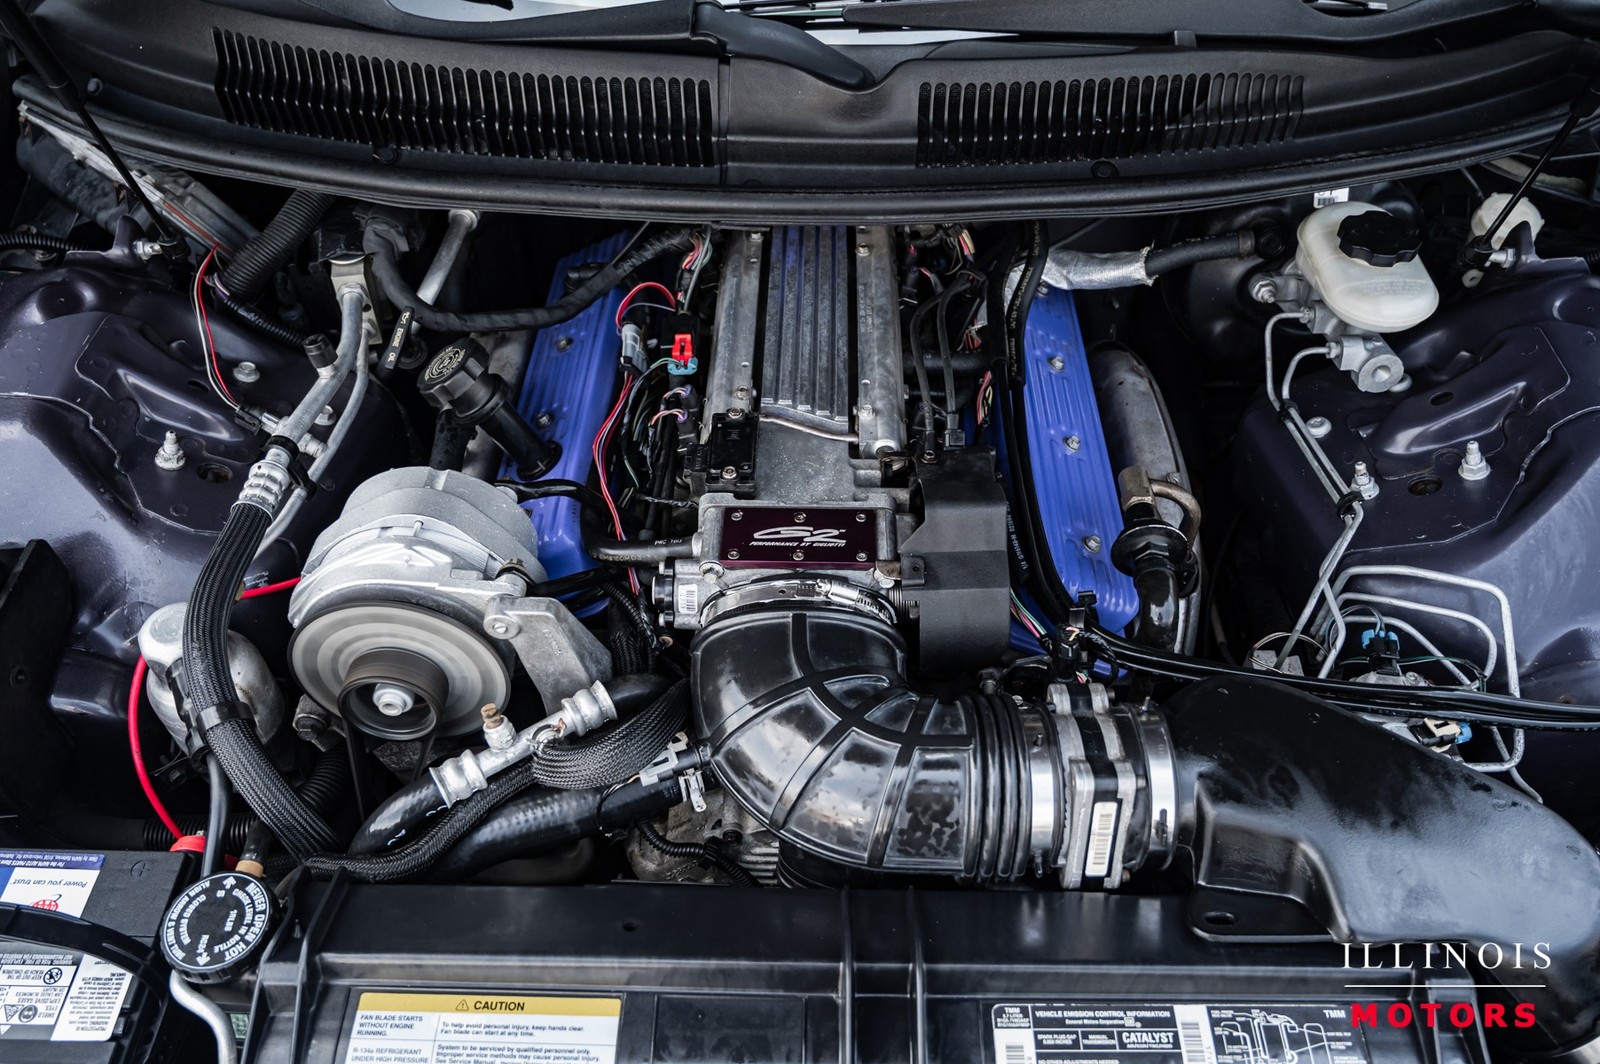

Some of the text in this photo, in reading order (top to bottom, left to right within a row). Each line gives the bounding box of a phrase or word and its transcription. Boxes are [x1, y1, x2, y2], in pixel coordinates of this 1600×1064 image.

[388, 328, 404, 362] ENGINE OIL
[64, 880, 88, 888] Power
[170, 895, 190, 920] ARROW
[213, 888, 253, 953] CHECK LEVEL IN BOTTLE
[224, 882, 266, 961] NEVER OPEN HOT
[166, 927, 176, 946] VENT
[178, 918, 191, 945] SYSTEM
[473, 1000, 525, 1012] CAUTION
[1323, 1010, 1346, 1018] TMM
[1122, 1032, 1174, 1043] CATALYST
[507, 1046, 514, 1054] by
[516, 1046, 543, 1054] qualified
[544, 1047, 575, 1055] personnel
[553, 1054, 580, 1062] personal
